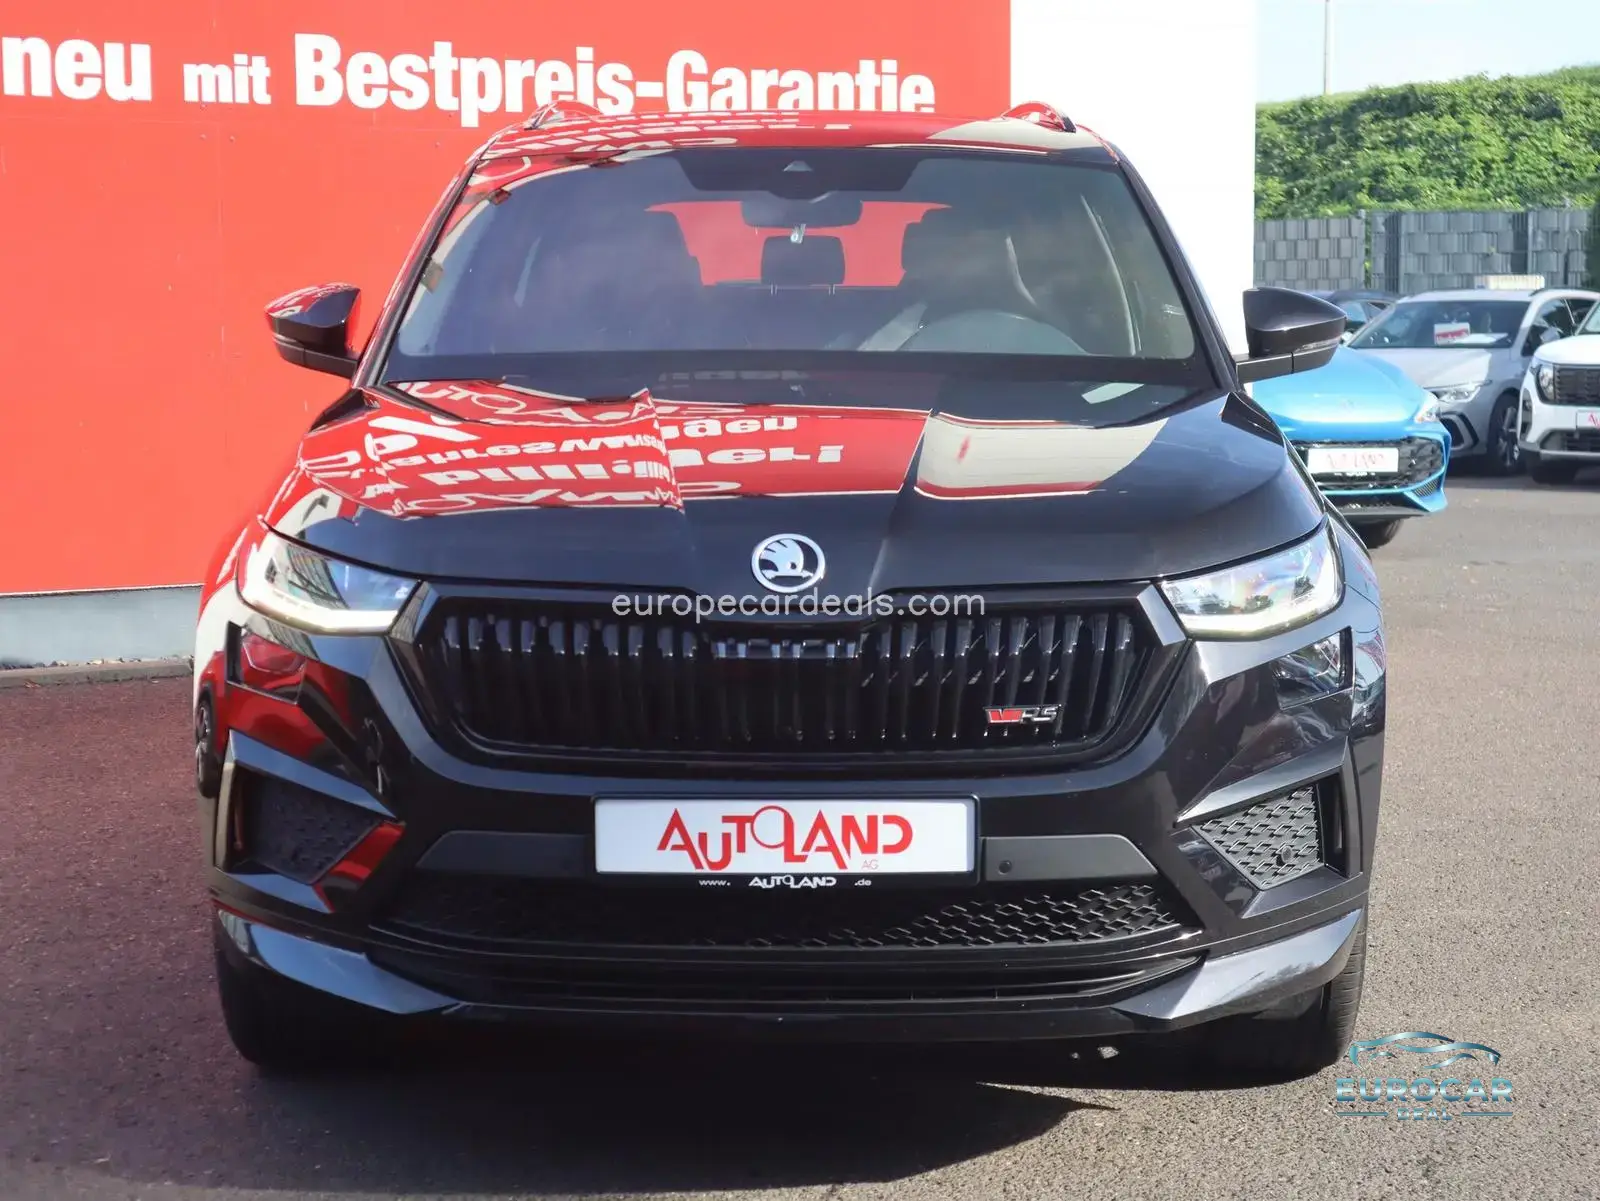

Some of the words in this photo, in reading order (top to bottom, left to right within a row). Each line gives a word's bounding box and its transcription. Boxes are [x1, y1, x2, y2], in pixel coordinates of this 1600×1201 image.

[2, 36, 152, 101] neu
[183, 53, 271, 104] mit
[294, 33, 936, 128] Bestpreis-Garantie
[698, 878, 732, 887] www.
